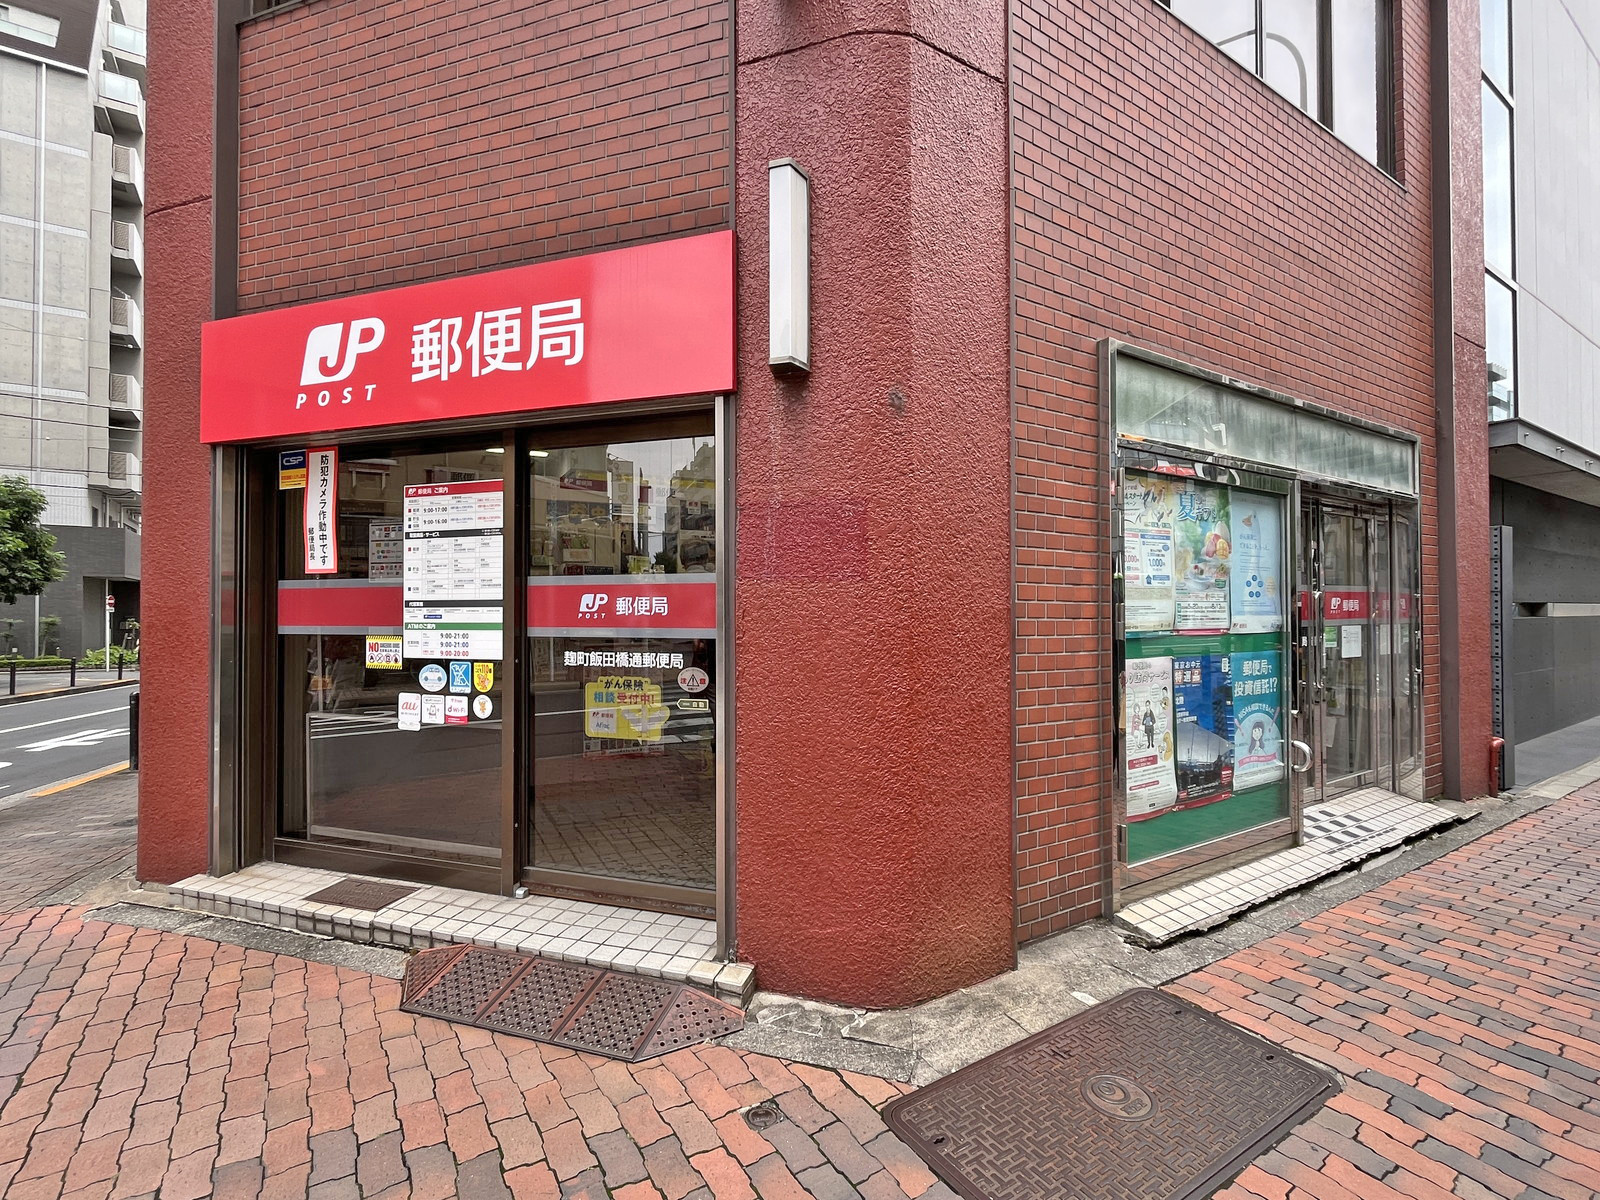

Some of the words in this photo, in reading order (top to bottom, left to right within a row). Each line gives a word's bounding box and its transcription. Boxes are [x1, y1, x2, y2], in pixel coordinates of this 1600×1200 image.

[411, 297, 585, 383] 郵便局
[300, 317, 386, 386] JP
[295, 384, 377, 410] POST
[283, 456, 304, 466] CSP
[319, 454, 330, 566] 防犯カメラ作動中です
[579, 593, 609, 612] JP
[615, 596, 669, 616] 郵便局
[368, 642, 379, 653] NO
[563, 651, 684, 670] 麹町飯田橋通郵便局
[1242, 659, 1273, 676] 郵便局で
[401, 701, 418, 711] au
